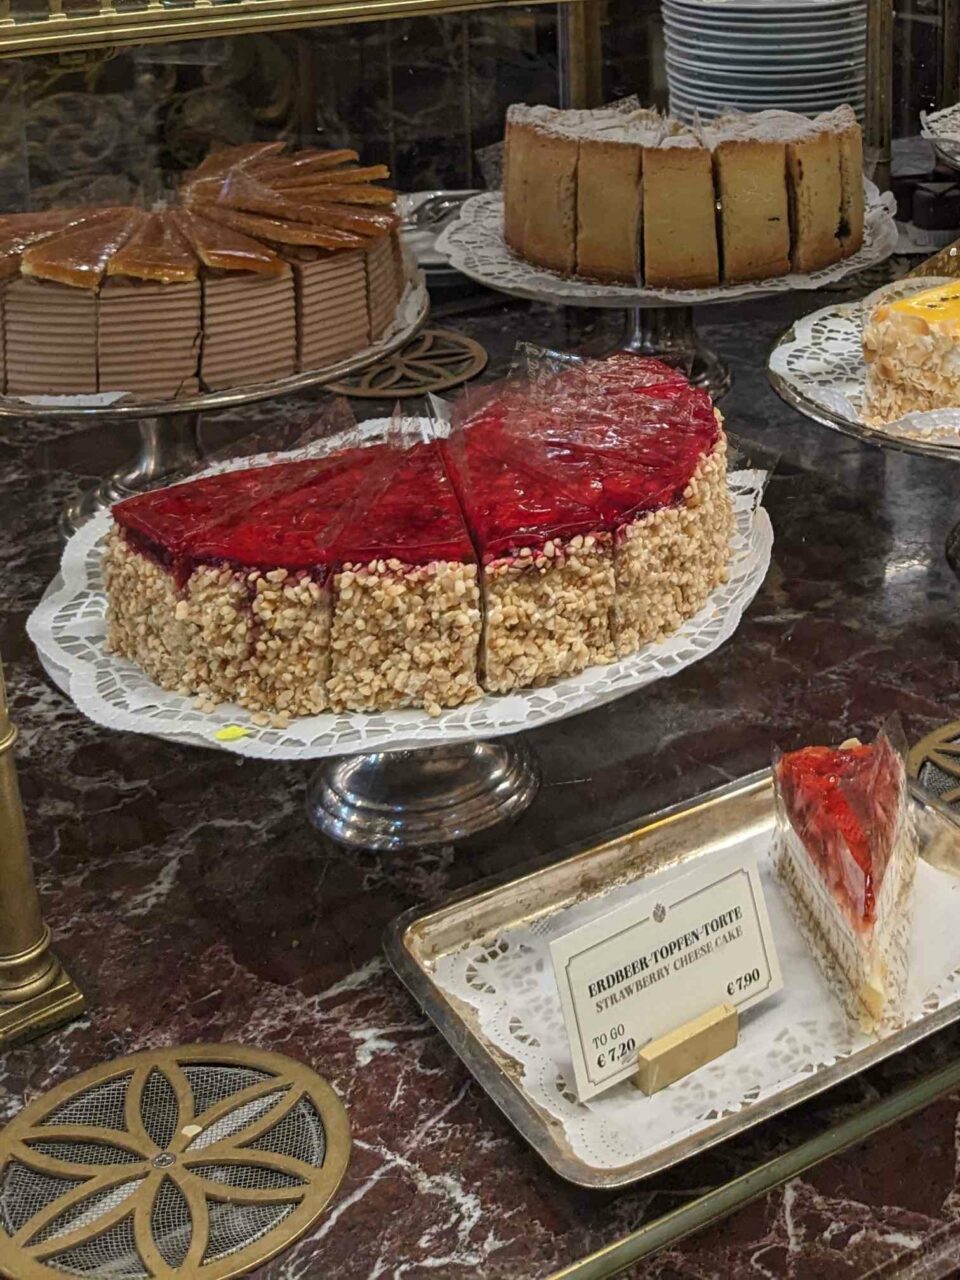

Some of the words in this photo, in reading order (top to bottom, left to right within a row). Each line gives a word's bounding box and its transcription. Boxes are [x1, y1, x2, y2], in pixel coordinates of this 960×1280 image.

[587, 905, 743, 999] ERDBEER-TOPFEN-TORTE
[595, 964, 671, 1014] STRAWBERRY
[673, 942, 714, 971] CHEESE
[714, 925, 744, 950] CAKE
[734, 967, 761, 992] 7,90
[592, 1034, 608, 1050] TO
[609, 1023, 625, 1039] GO
[607, 1037, 637, 1062] 7,20
